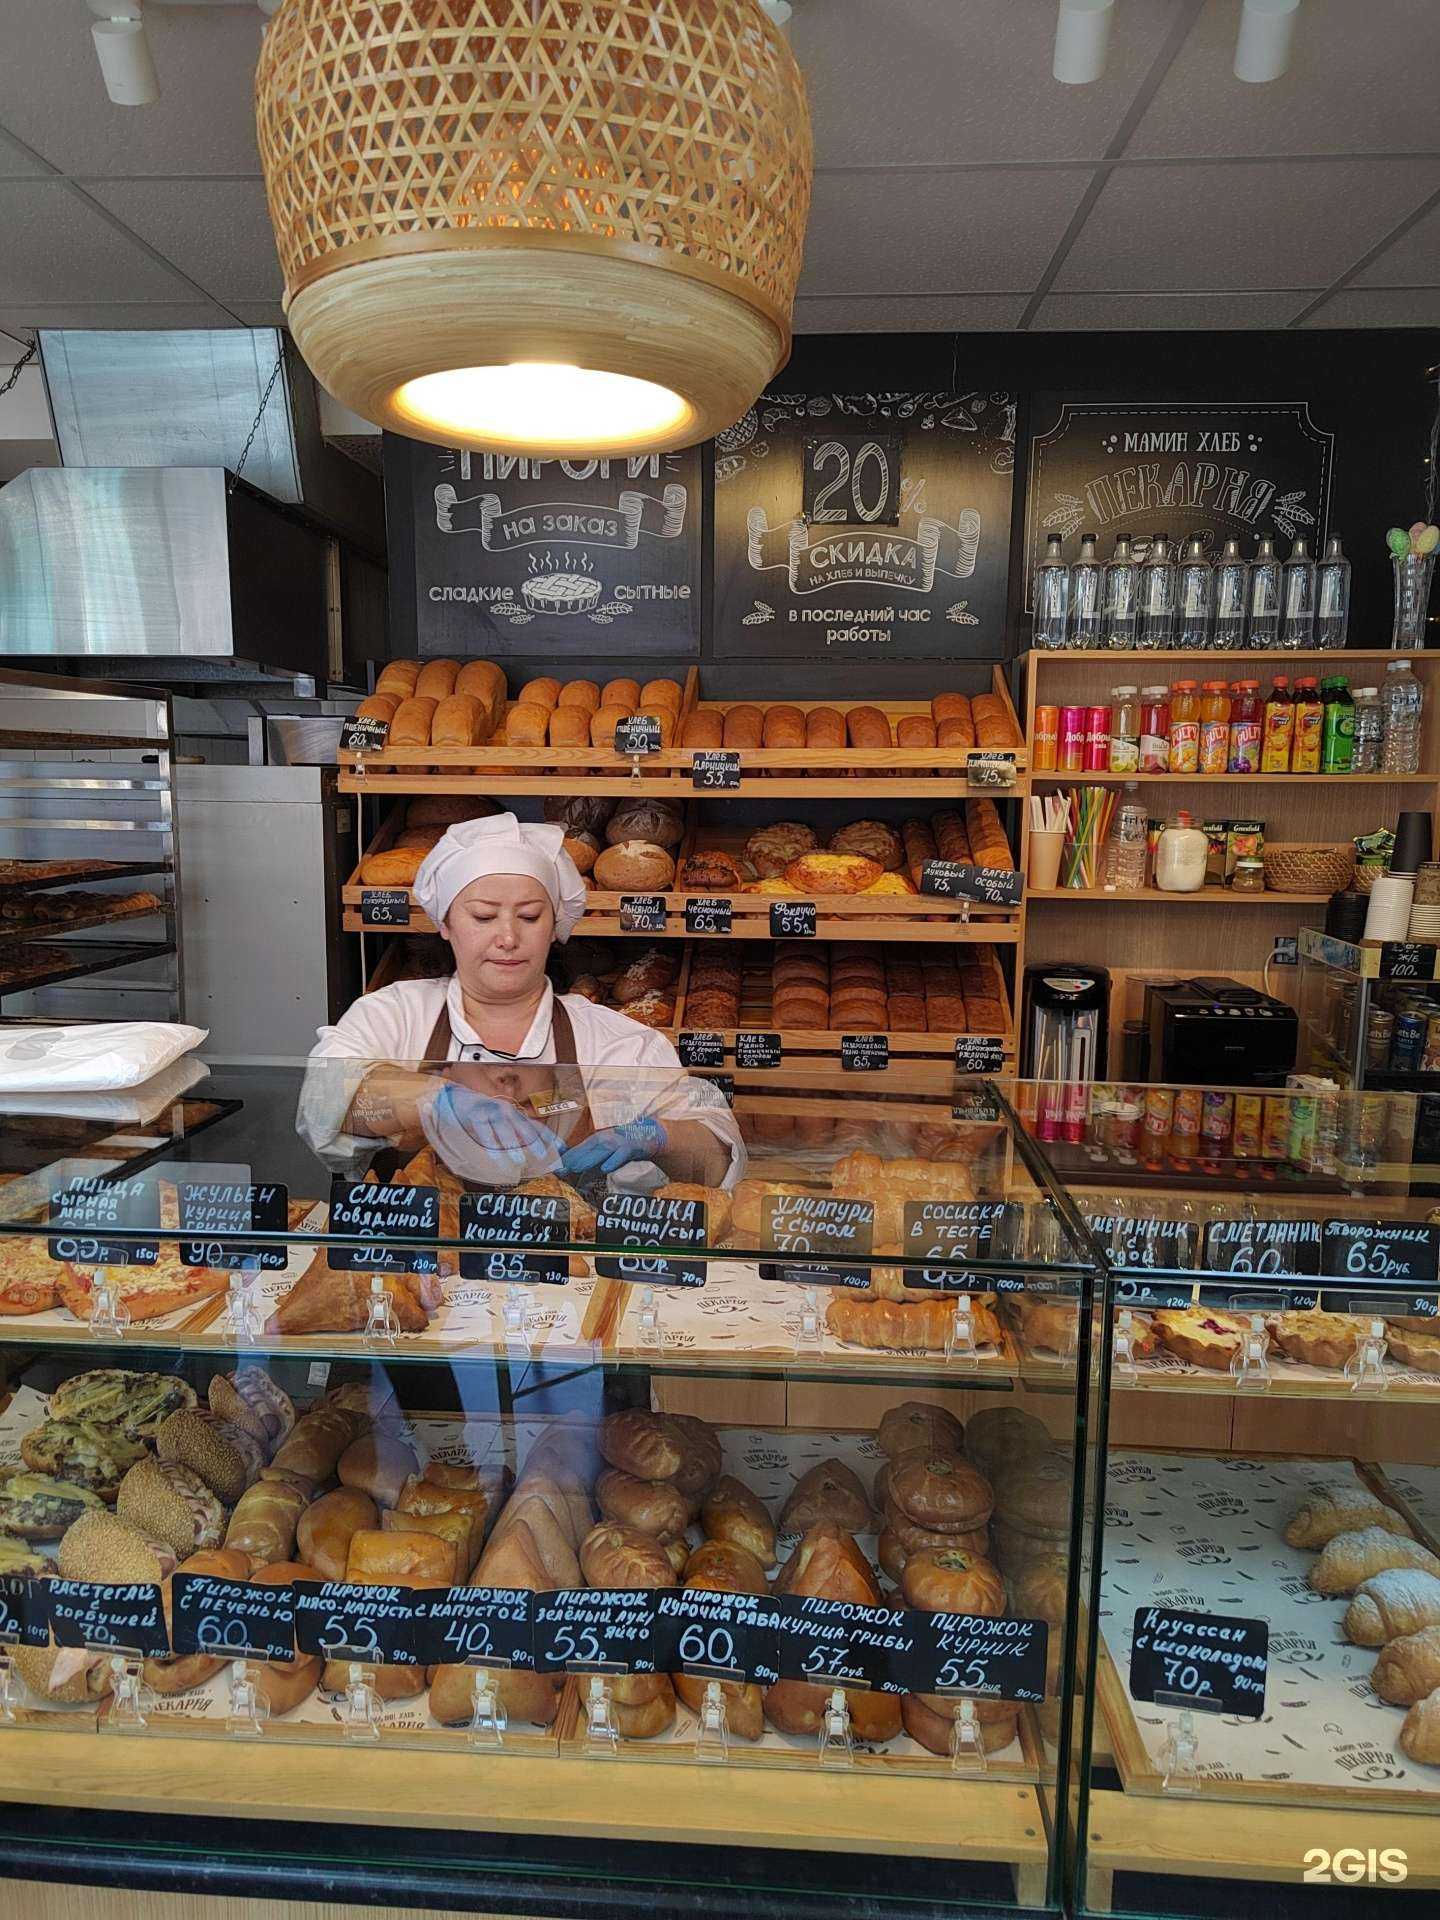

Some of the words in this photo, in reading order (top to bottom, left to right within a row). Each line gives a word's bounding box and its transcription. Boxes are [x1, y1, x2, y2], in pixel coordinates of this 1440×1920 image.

[1124, 432, 1188, 452] МАМИН
[1198, 432, 1241, 452] ХЛЕБ
[813, 441, 890, 522] 20
[1085, 462, 1277, 524] ПЕКАРНЯ
[503, 517, 536, 541] на
[542, 514, 618, 537] заказ
[809, 542, 918, 570] СКИДКА
[809, 574, 826, 587] НА
[826, 568, 854, 582] ХЛЕБ
[855, 568, 863, 577] И
[864, 568, 916, 587] ВЫПЕЧКУ
[428, 585, 515, 603] сладкие
[614, 584, 692, 600] сытные
[801, 606, 895, 624] последний
[898, 609, 931, 622] час
[826, 627, 891, 645] работы
[69, 1176, 145, 1197] ПИЦЦА
[184, 1185, 277, 1203] ЖУЛЬЕН
[349, 1184, 417, 1205] САМСА
[52, 1192, 119, 1209] СЫРНАЯ
[476, 1194, 558, 1220] САМСА
[602, 1195, 697, 1223] СЛОЙКА
[771, 1196, 873, 1223] ХАЧАПУРИ
[59, 1208, 118, 1221] МАРГО
[185, 1207, 262, 1222] КУРИЦА-
[922, 1204, 1005, 1220] СОСИСКА
[789, 1218, 856, 1238] СЫРОМ
[936, 1225, 992, 1239] ТЕСТЕ
[1209, 1221, 1320, 1244] СМЕТАННИК
[320, 1582, 401, 1602] ПИРОЖОК
[446, 1586, 529, 1607] ПИРОЖОК
[554, 1591, 649, 1607] ПИРОЖОК
[682, 1589, 760, 1609] ПИРОЖОК
[429, 1603, 528, 1622] КАПУСТОЙ
[657, 1597, 732, 1621] КУРОЧКА
[801, 1597, 905, 1627] ПИРОЖОК
[780, 1615, 914, 1651] КУРИЦА-ГРИБЫ
[930, 1612, 1034, 1637] ПИРОЖОК
[1143, 1608, 1247, 1643] Круассан
[936, 1633, 1030, 1657] КУРНИК
[1152, 1639, 1268, 1673] шоколадом
